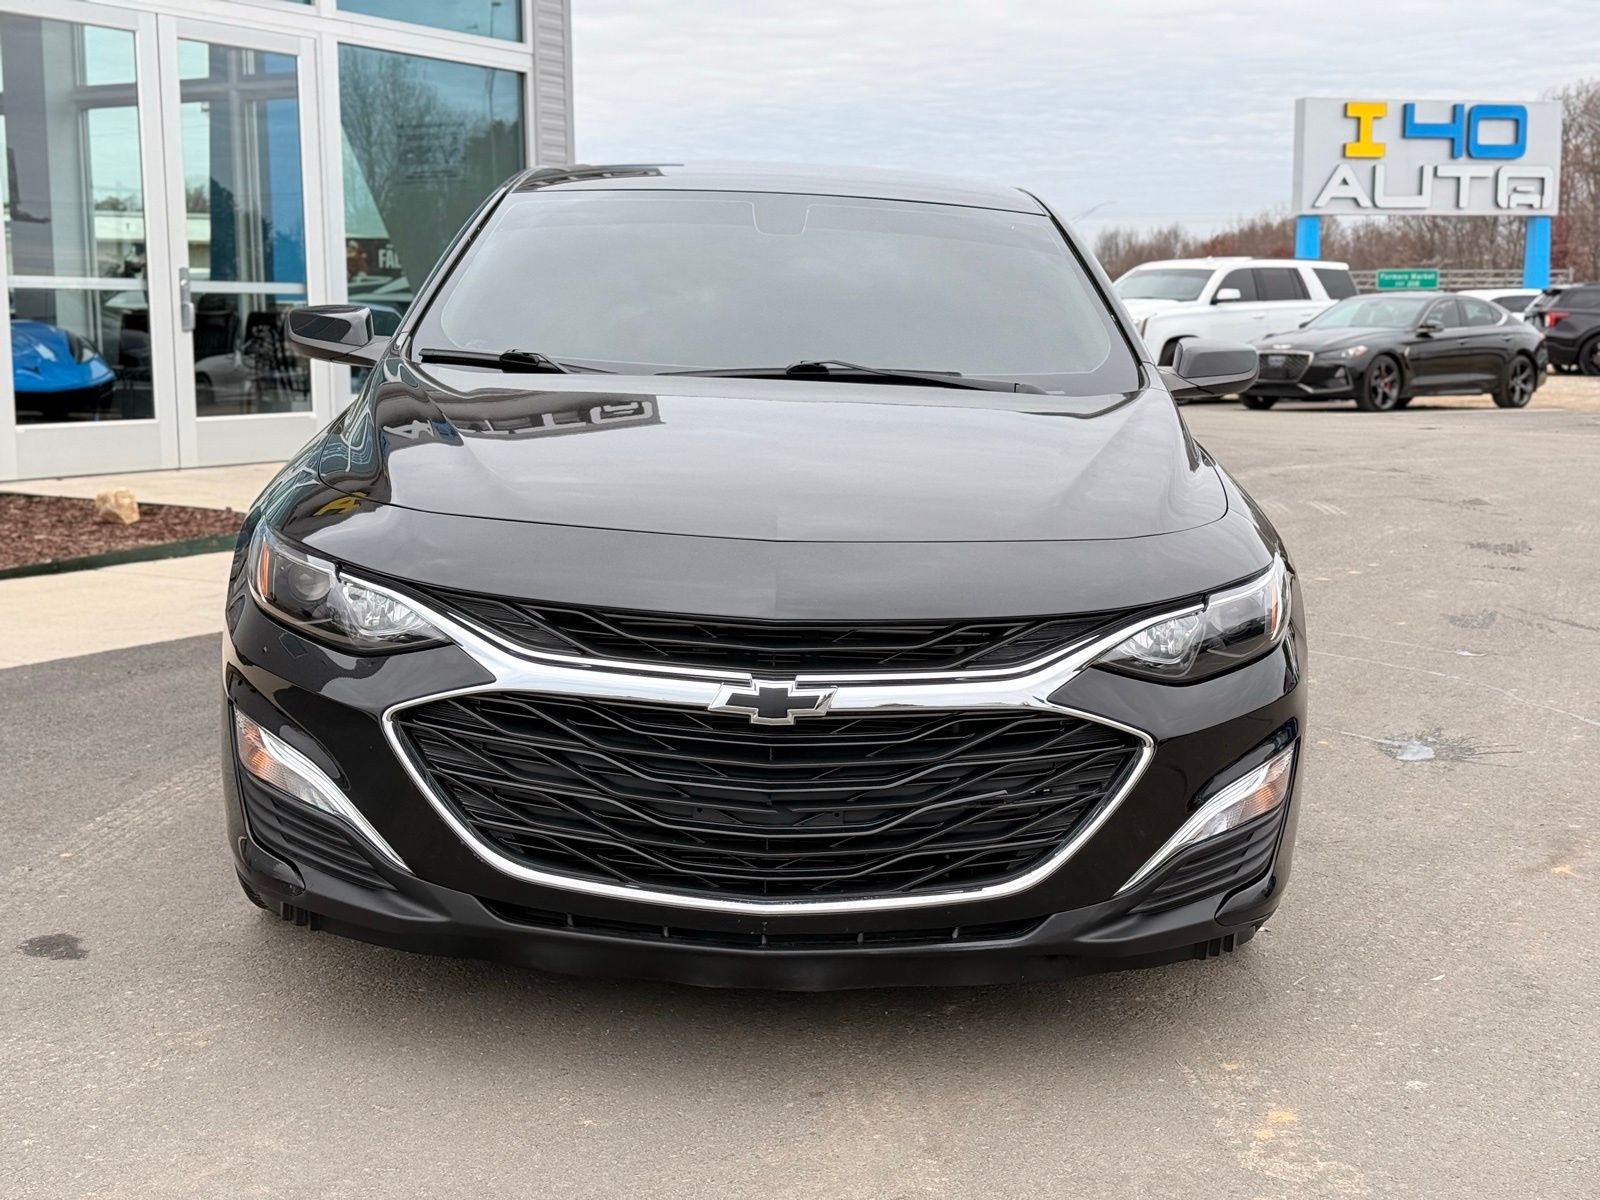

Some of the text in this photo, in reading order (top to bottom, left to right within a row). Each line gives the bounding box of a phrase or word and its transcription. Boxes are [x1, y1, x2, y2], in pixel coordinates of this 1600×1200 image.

[1343, 101, 1528, 160] I 40
[1410, 272, 1436, 280] Market
